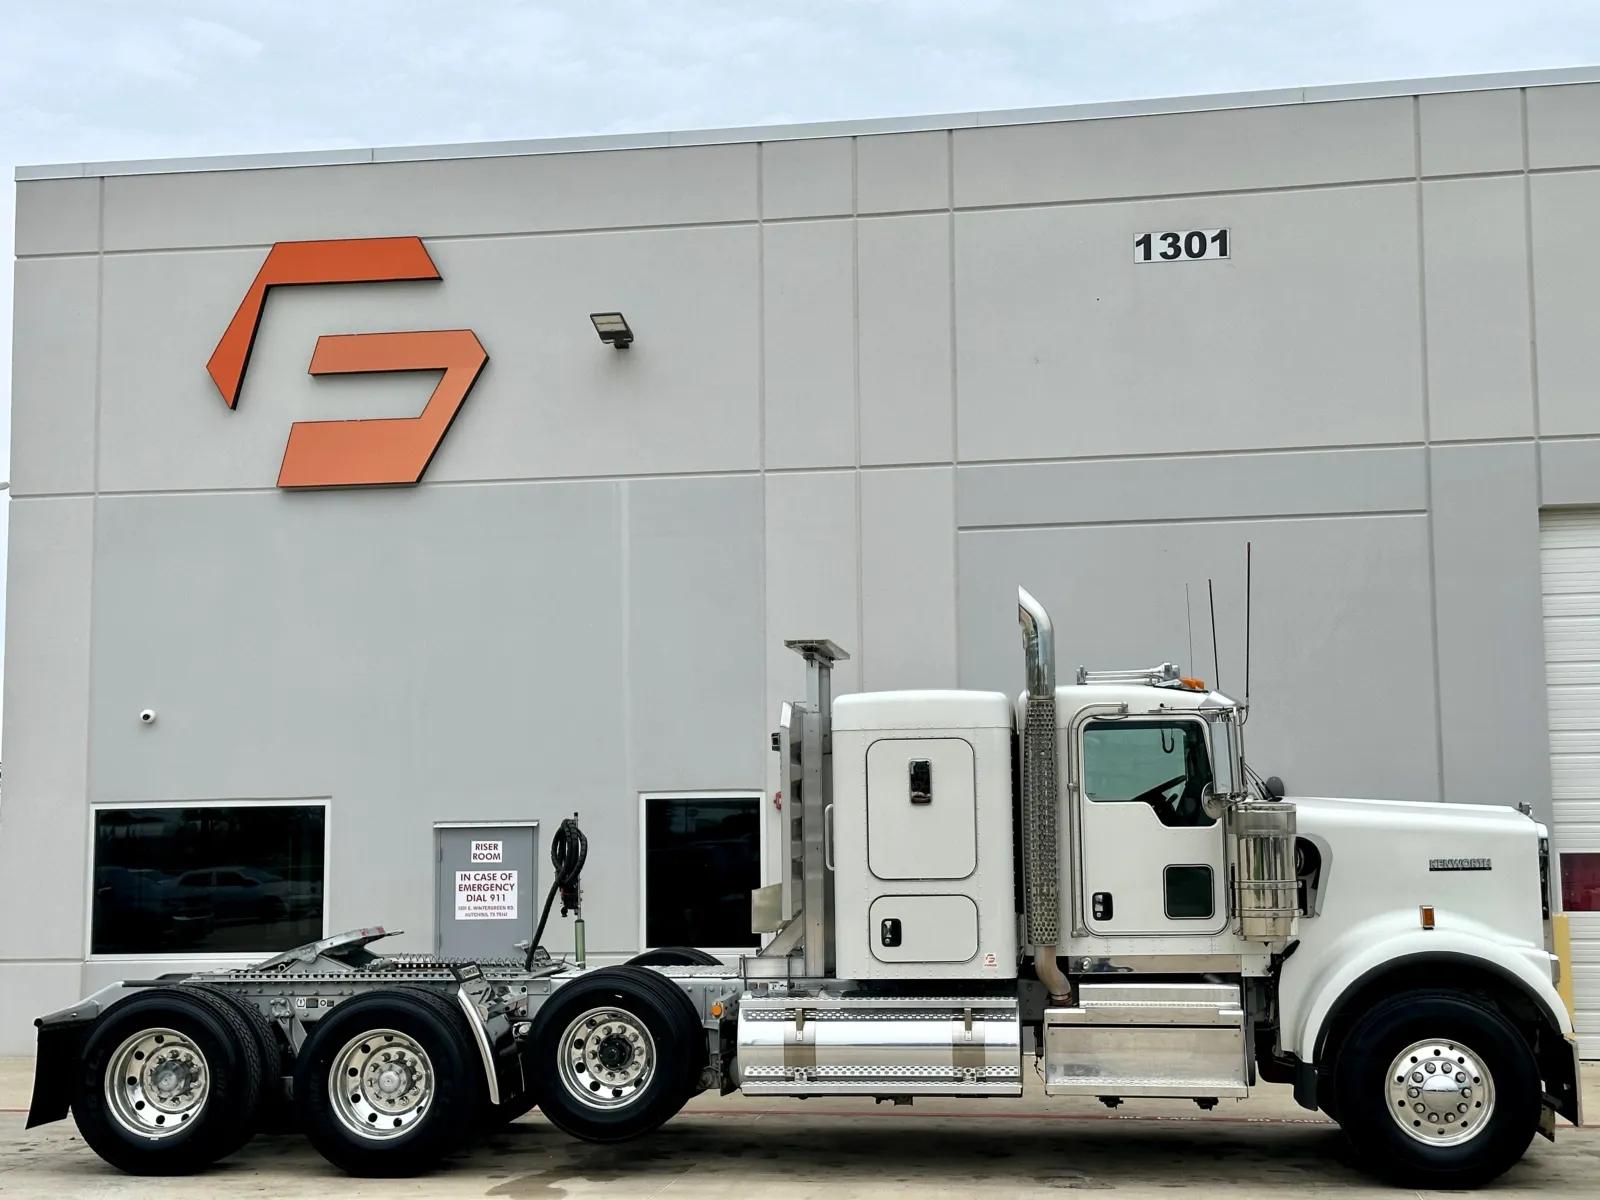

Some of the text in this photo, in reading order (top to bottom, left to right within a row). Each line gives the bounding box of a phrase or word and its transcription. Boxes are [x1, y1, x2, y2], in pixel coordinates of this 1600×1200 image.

[1136, 229, 1228, 261] 1301
[475, 843, 499, 851] RISER
[472, 852, 501, 861] ROOM
[1429, 858, 1492, 870] KENWORTH
[460, 872, 513, 881] IN CASE OF
[458, 883, 515, 892] EMERGENCY
[466, 894, 506, 902] DIAL 911
